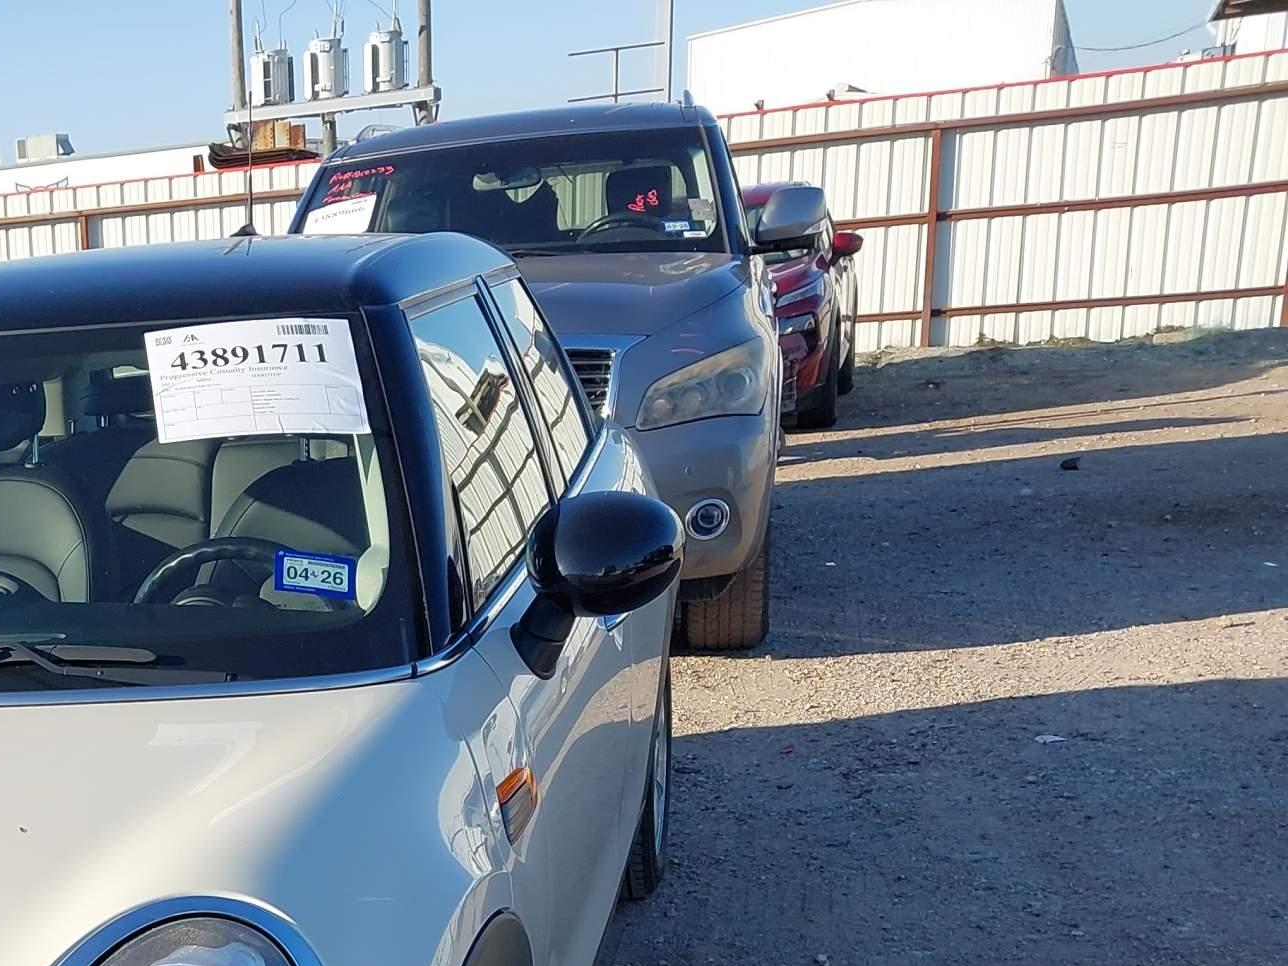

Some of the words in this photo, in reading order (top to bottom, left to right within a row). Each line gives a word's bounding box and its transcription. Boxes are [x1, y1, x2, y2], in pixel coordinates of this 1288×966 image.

[171, 343, 329, 371] 43891711
[160, 370, 208, 382] Progressive
[210, 366, 246, 375] Casualty
[248, 364, 289, 373] Insurance
[286, 565, 310, 581] 04
[320, 569, 344, 586] 26
